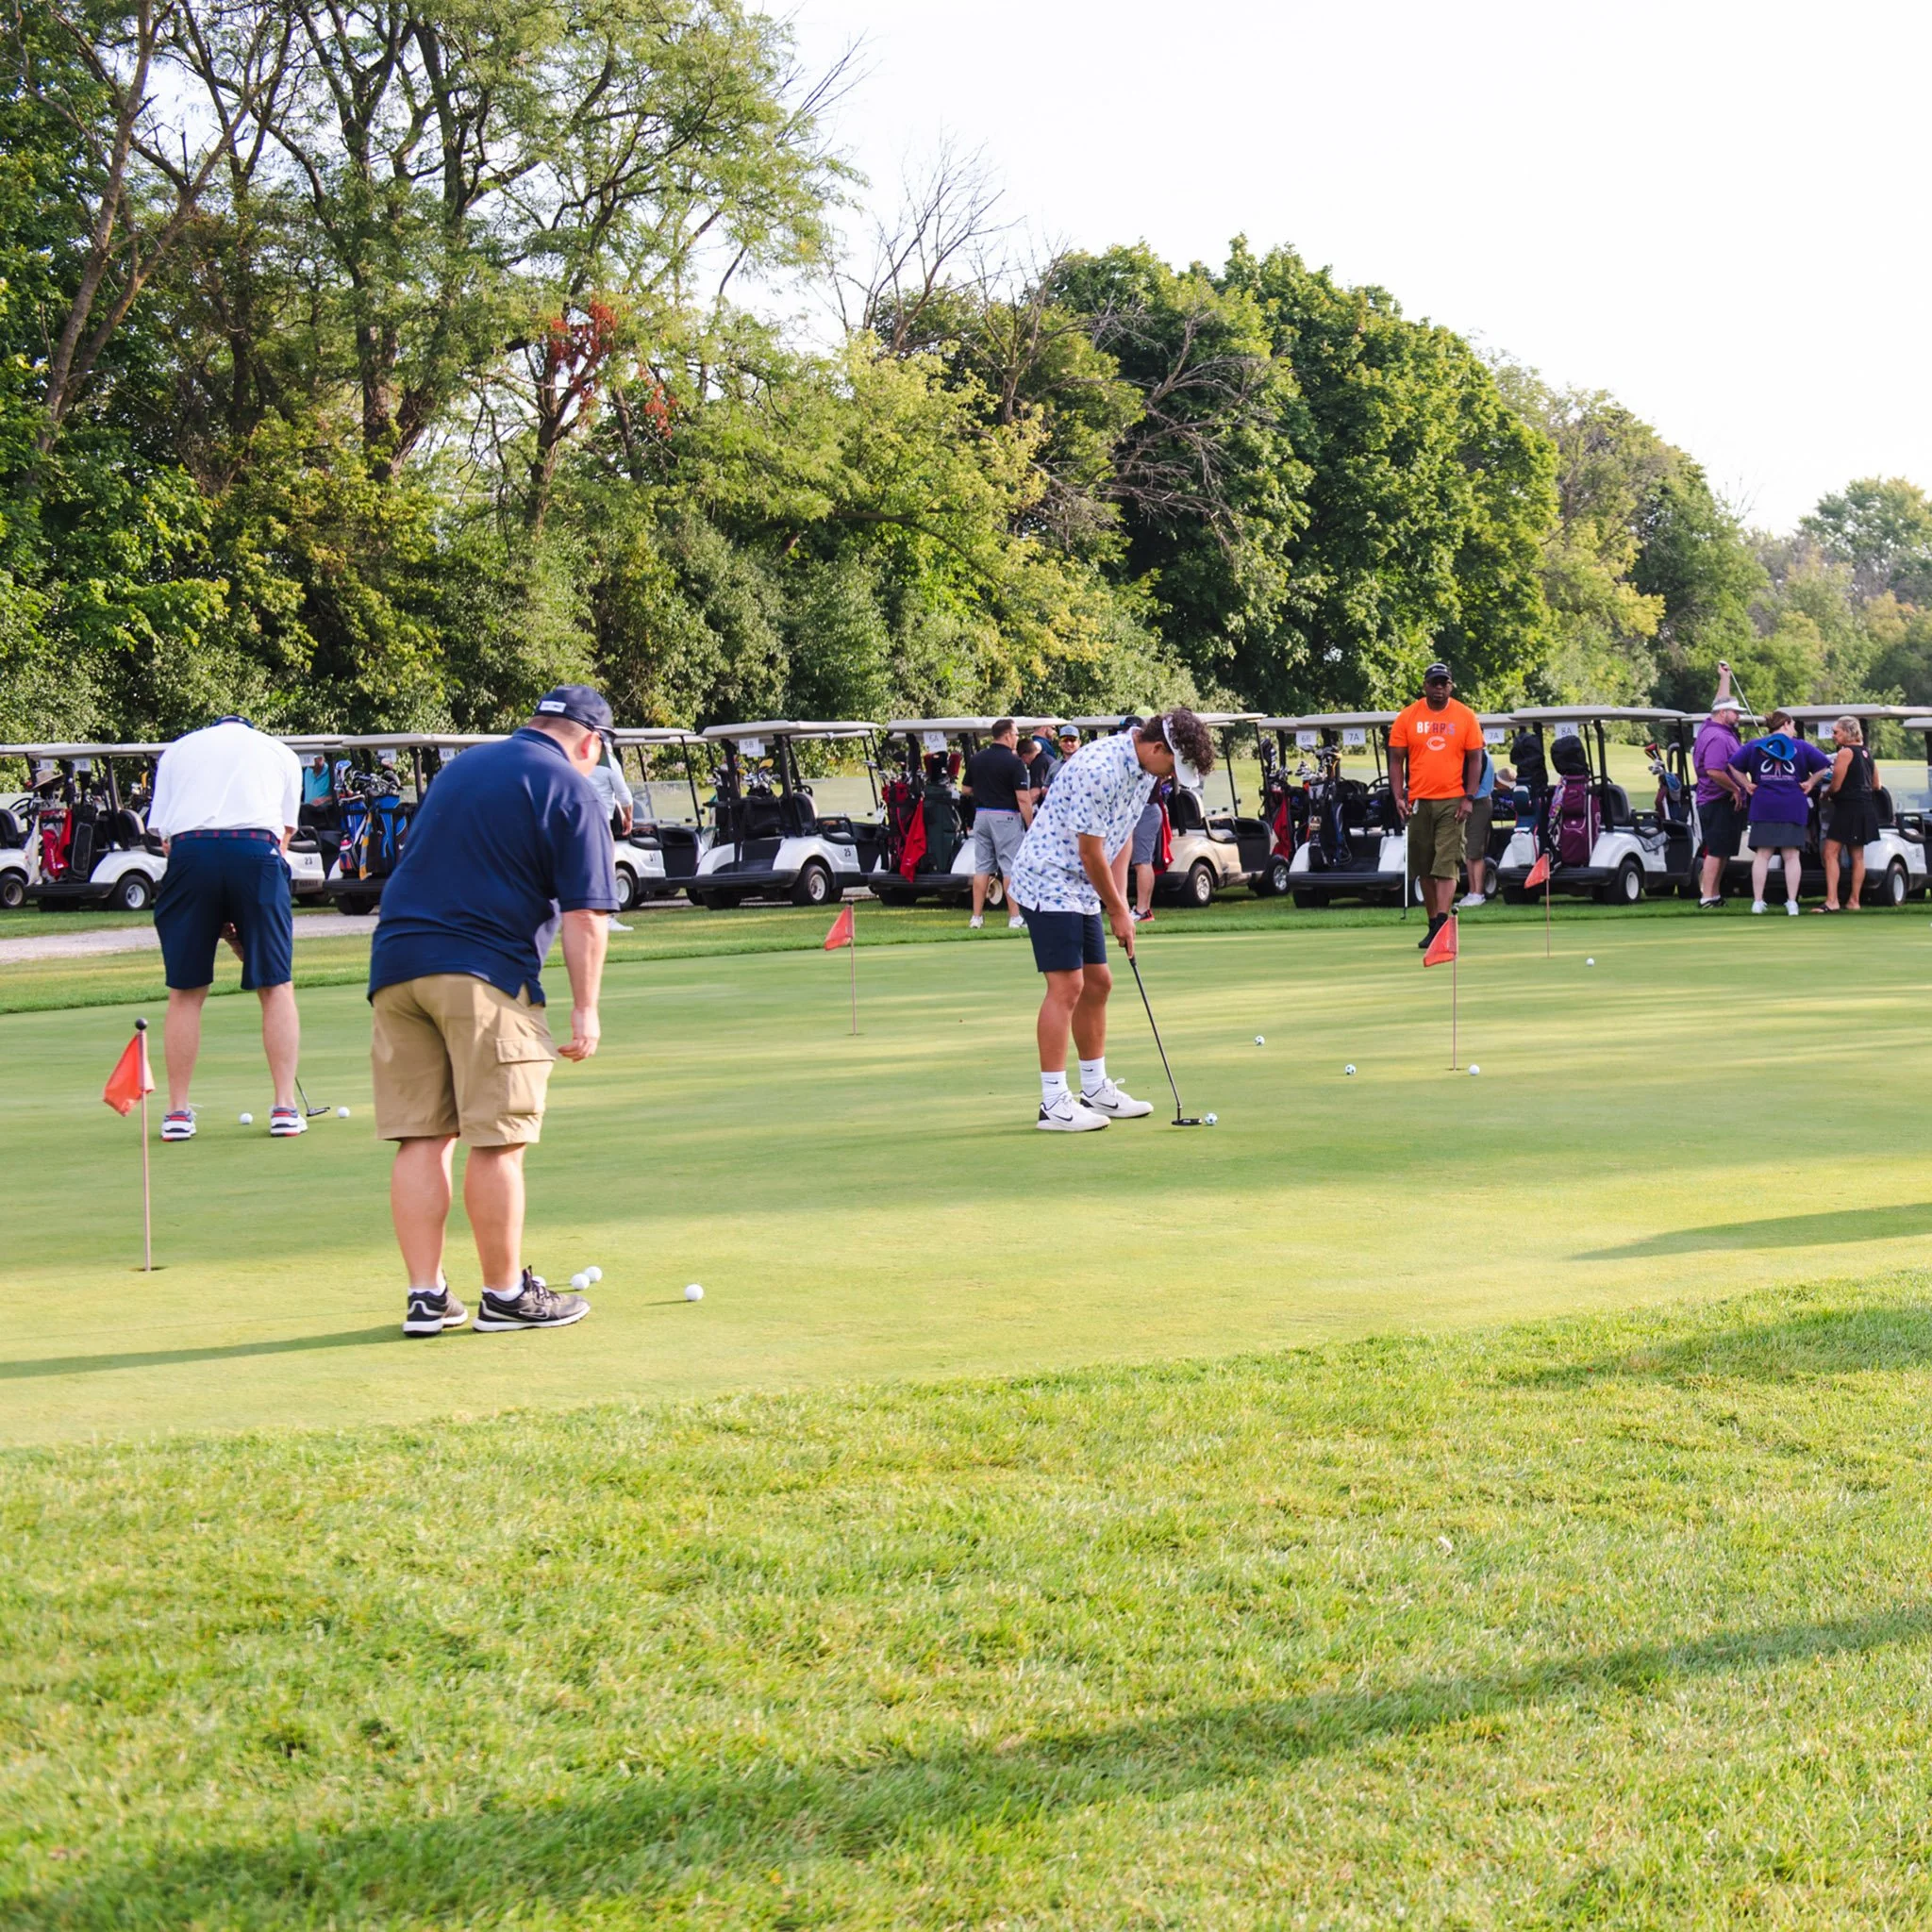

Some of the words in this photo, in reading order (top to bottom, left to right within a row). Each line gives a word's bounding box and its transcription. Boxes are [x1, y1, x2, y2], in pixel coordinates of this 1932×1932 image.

[1416, 722, 1456, 735] BEARS
[1561, 727, 1572, 736] 8A
[1349, 733, 1359, 741] 7A
[1490, 732, 1499, 741] 7A
